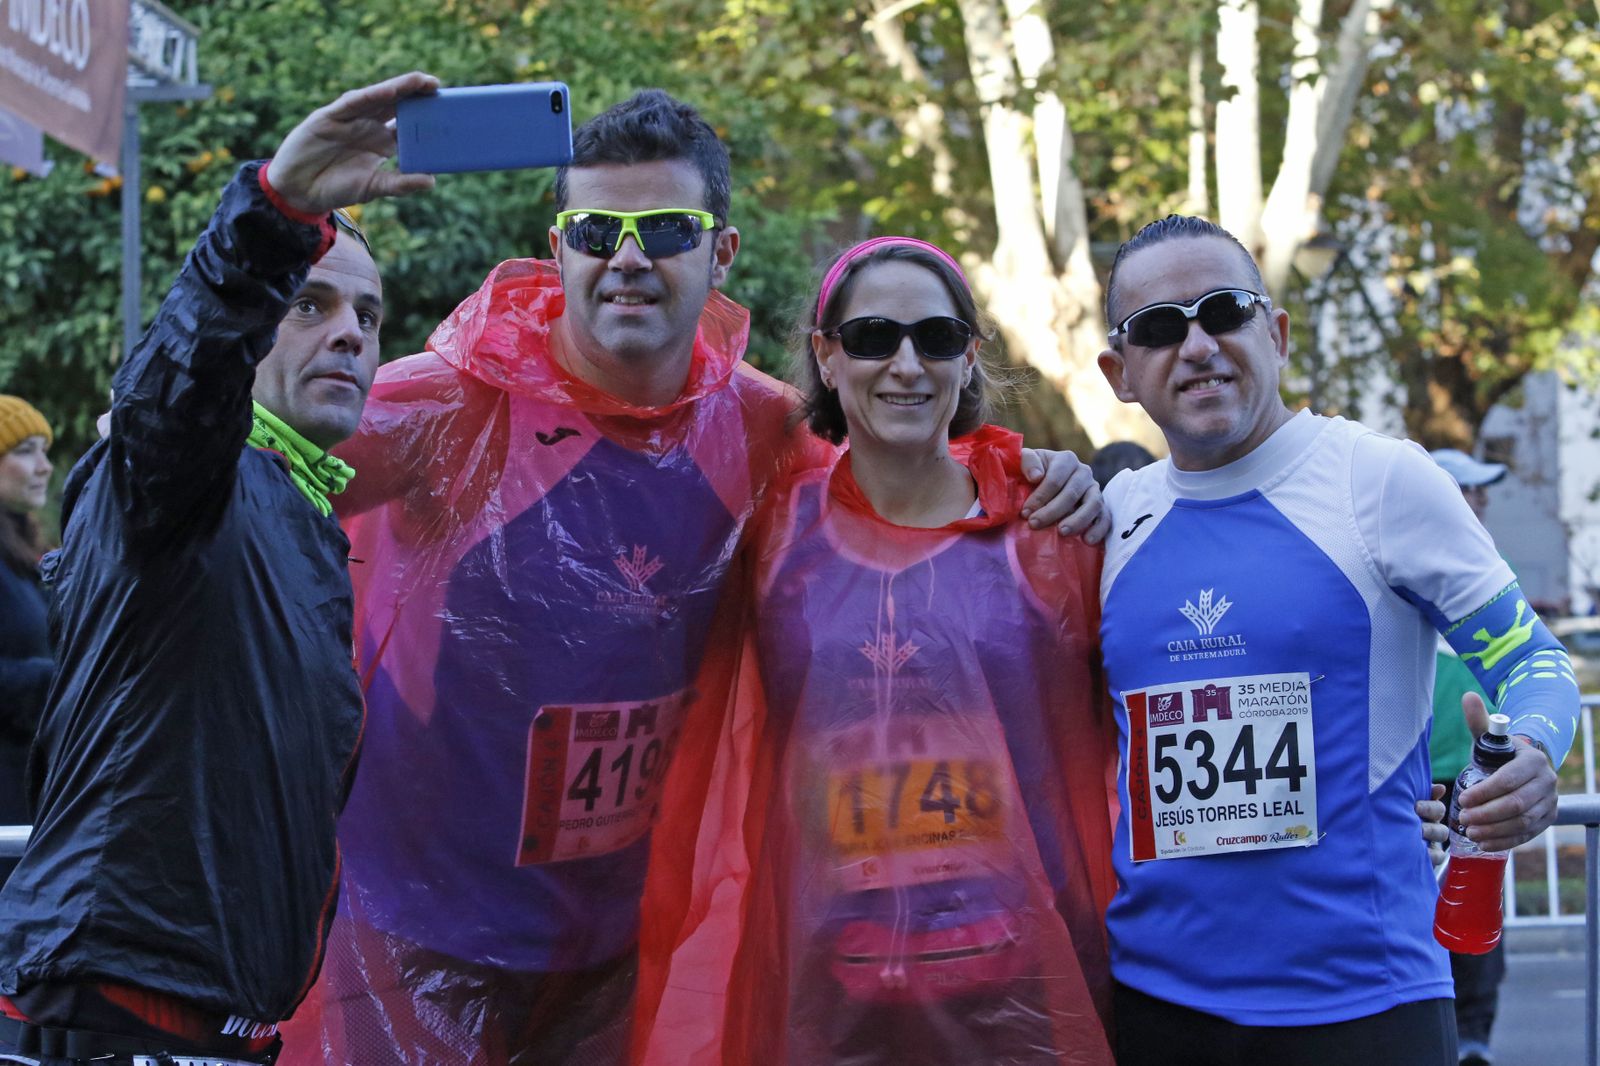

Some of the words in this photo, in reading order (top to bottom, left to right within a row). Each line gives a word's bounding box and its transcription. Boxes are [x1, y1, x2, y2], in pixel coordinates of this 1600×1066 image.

[1167, 639, 1199, 652] CAJA
[1199, 634, 1246, 649] RURAL
[1169, 654, 1180, 662] DE
[1182, 648, 1247, 661] EXTREMADURA
[1205, 689, 1217, 697] 35
[1238, 684, 1255, 695] 35
[1259, 681, 1307, 694] MEDIA
[1238, 693, 1308, 708] MARATÓN
[1150, 710, 1183, 724] IMDECO
[1154, 721, 1307, 804] 5344
[1155, 806, 1194, 828] JESÚS
[1198, 803, 1258, 824] TORRES
[1263, 800, 1304, 818] LEAL
[559, 817, 594, 831] PEDRO
[1216, 833, 1267, 847] Cruzcampo
[1269, 831, 1299, 844] Radler
